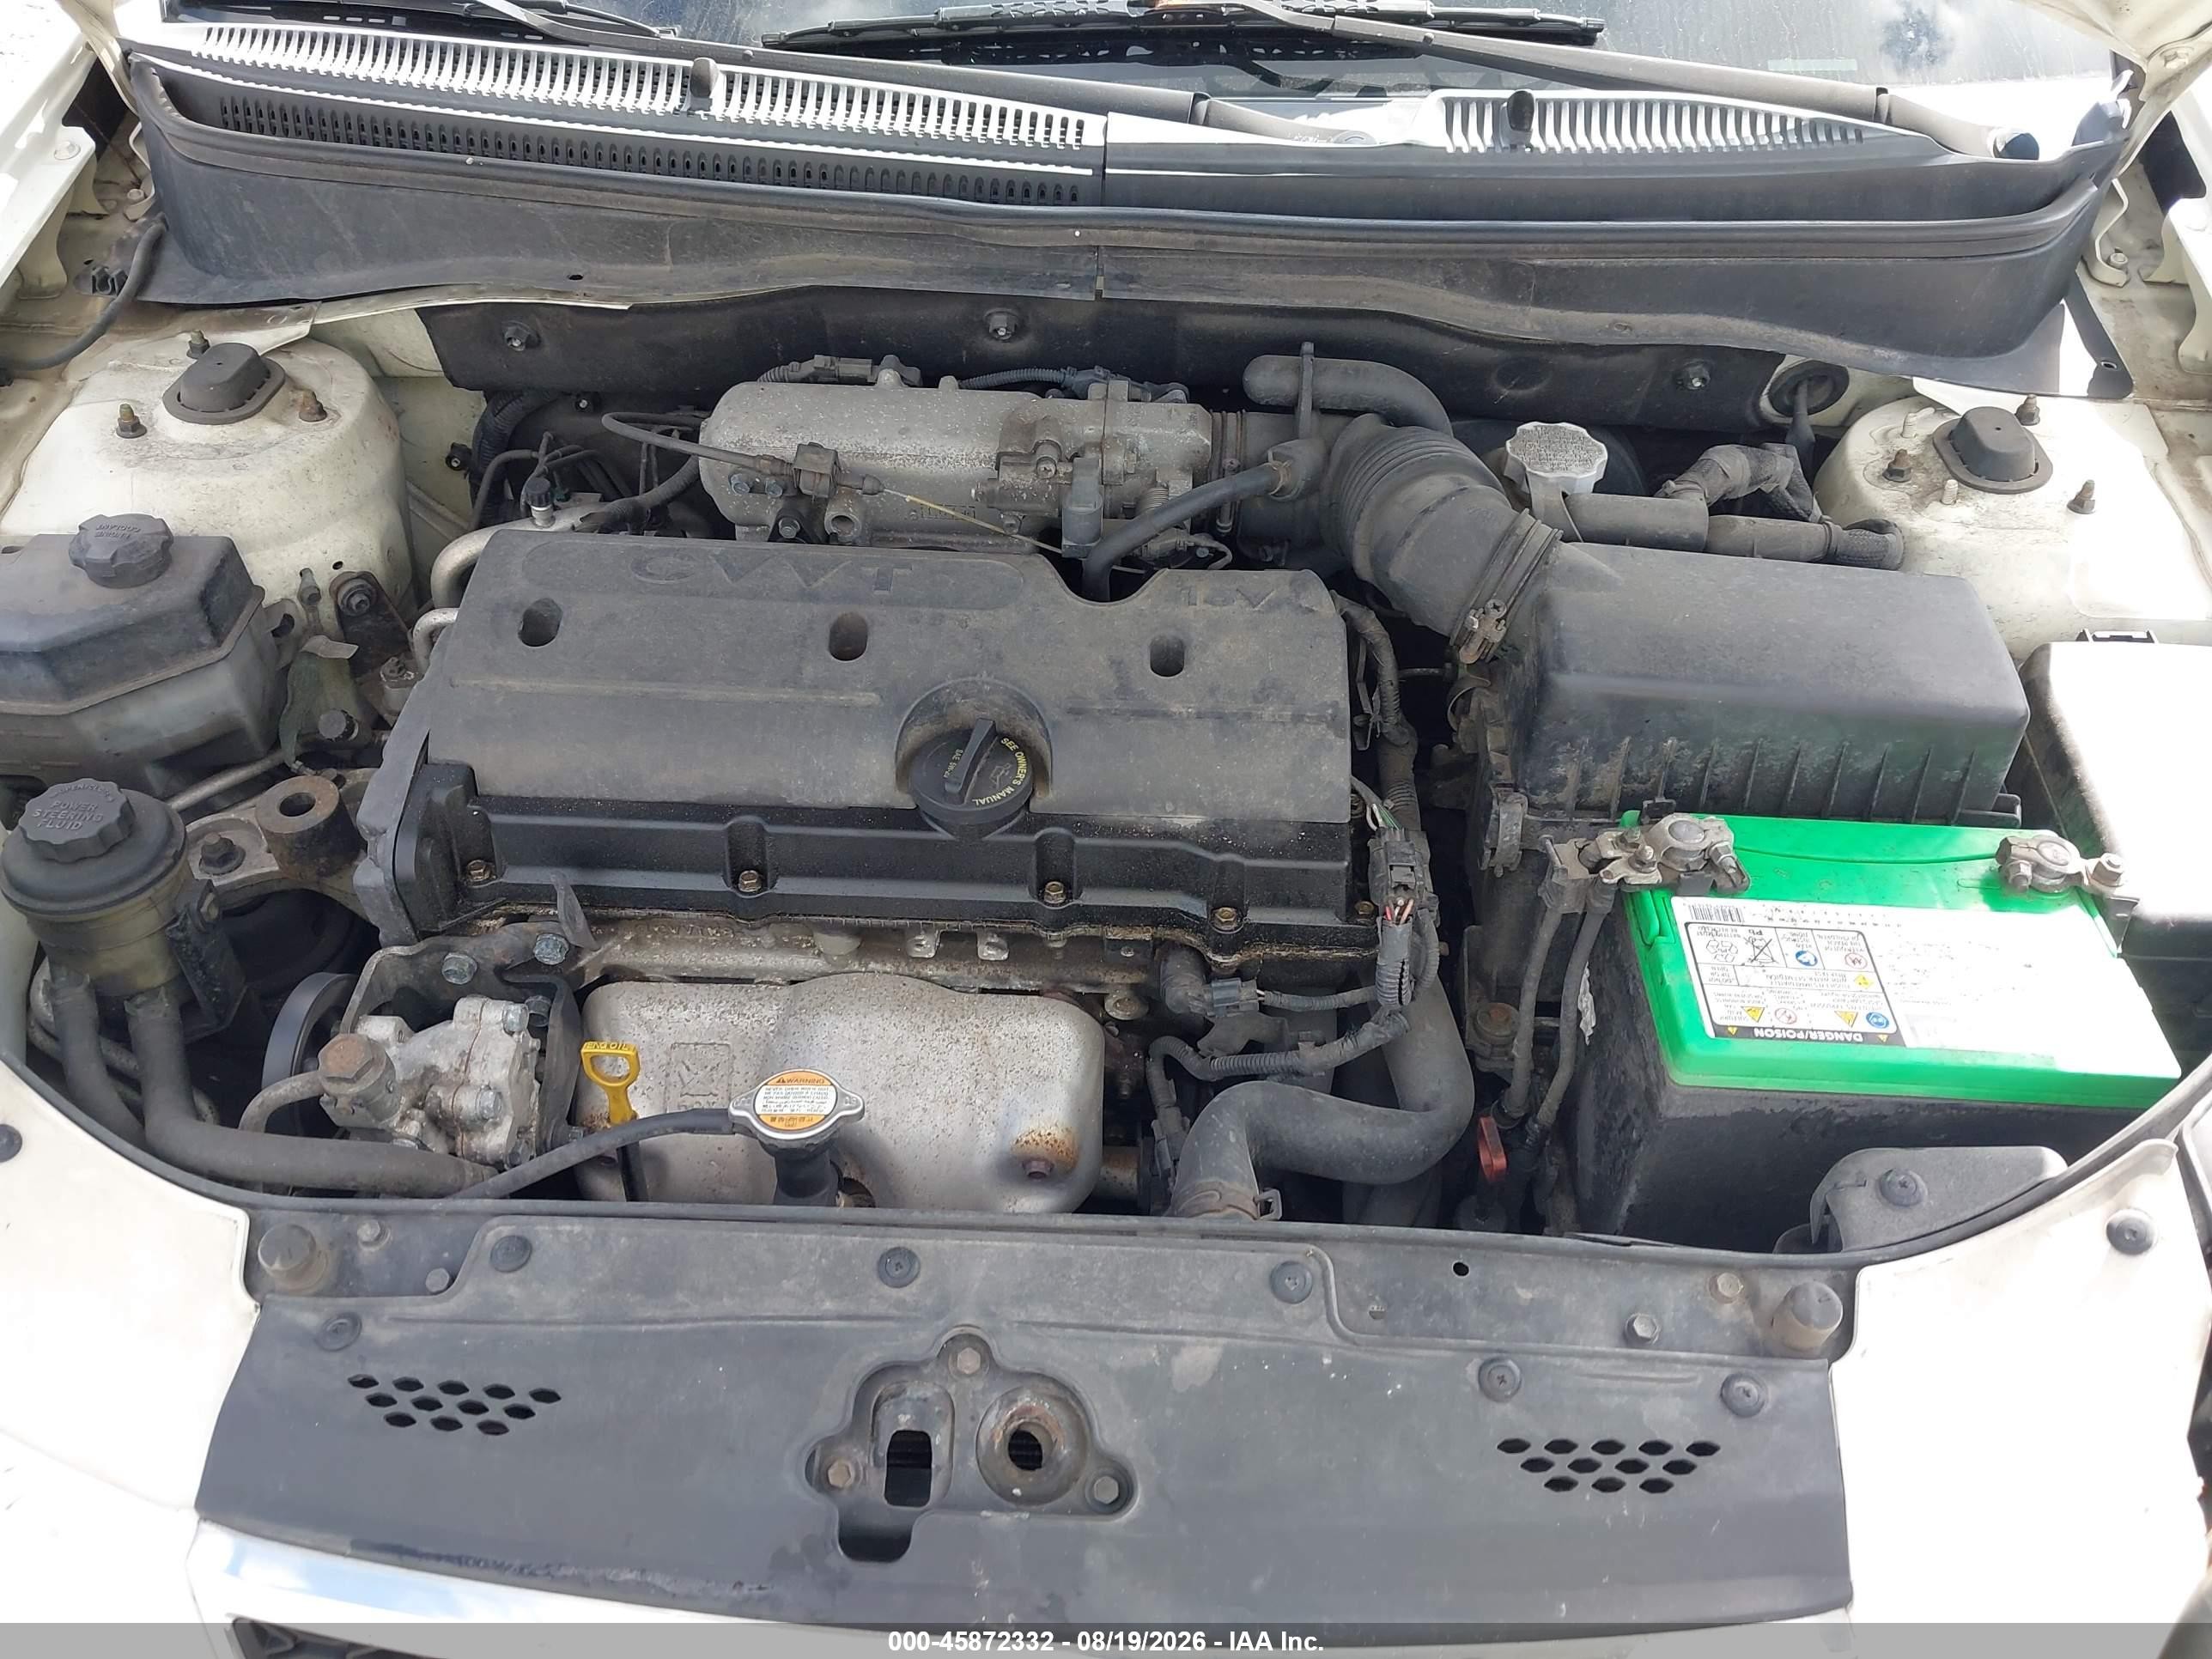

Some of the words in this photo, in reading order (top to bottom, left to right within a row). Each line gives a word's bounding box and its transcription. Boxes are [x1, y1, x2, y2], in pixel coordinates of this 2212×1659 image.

[96, 524, 142, 532] COOLANT
[629, 549, 913, 593] CVVT
[1000, 738, 1019, 751] SEE
[951, 749, 963, 761] SAE
[1012, 751, 1028, 786] OWNER'S
[972, 785, 1015, 806] MANUAL
[50, 800, 98, 812] POWER
[33, 809, 104, 823] STEERING
[37, 818, 83, 830] FLUID
[1754, 1027, 1863, 1042] DANGER/POISON
[610, 1042, 629, 1051] OIL
